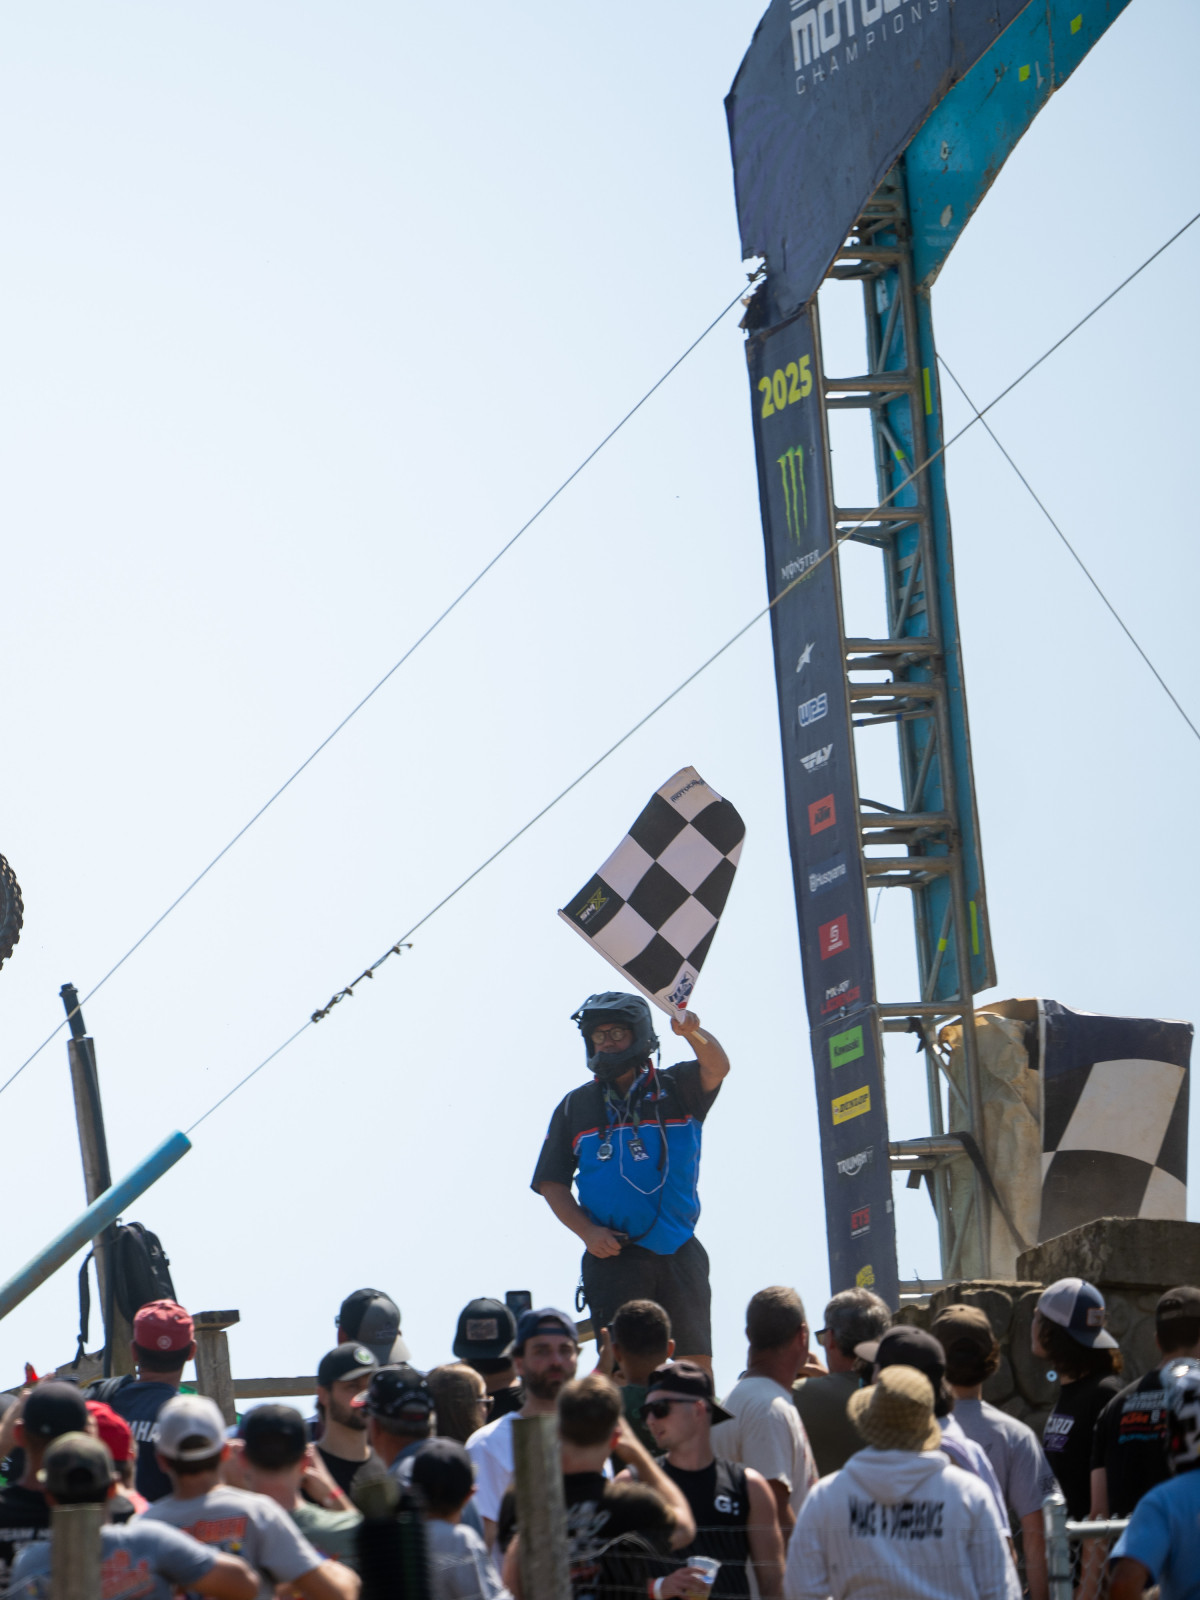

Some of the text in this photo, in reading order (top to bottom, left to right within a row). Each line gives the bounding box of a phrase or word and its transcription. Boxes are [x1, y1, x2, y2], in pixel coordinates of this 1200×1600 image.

[789, 0, 908, 71] MOTO
[795, 0, 955, 95] CHAMPIONS
[758, 354, 812, 418] 2025
[781, 549, 820, 580] MONSTER
